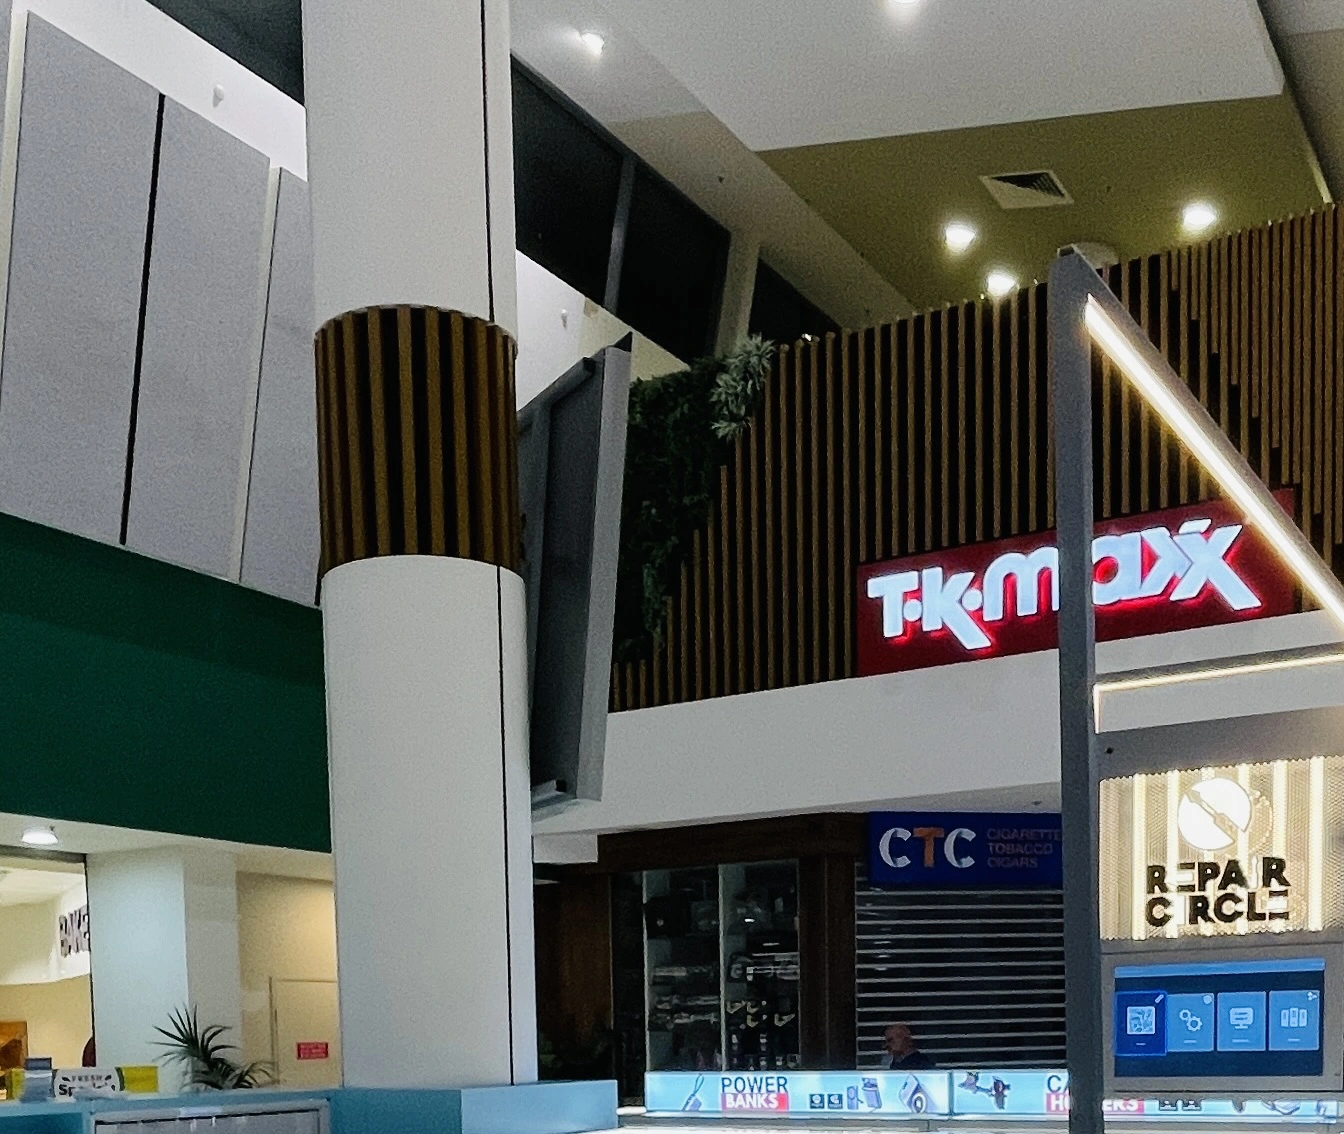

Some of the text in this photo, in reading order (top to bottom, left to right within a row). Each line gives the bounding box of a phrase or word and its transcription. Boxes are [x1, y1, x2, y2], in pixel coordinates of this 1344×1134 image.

[879, 827, 976, 868] CTC
[988, 843, 1053, 855] TOBACCO
[987, 857, 1038, 868] CIGARS
[721, 1076, 788, 1093] POWER
[725, 1093, 780, 1110] BANKS
